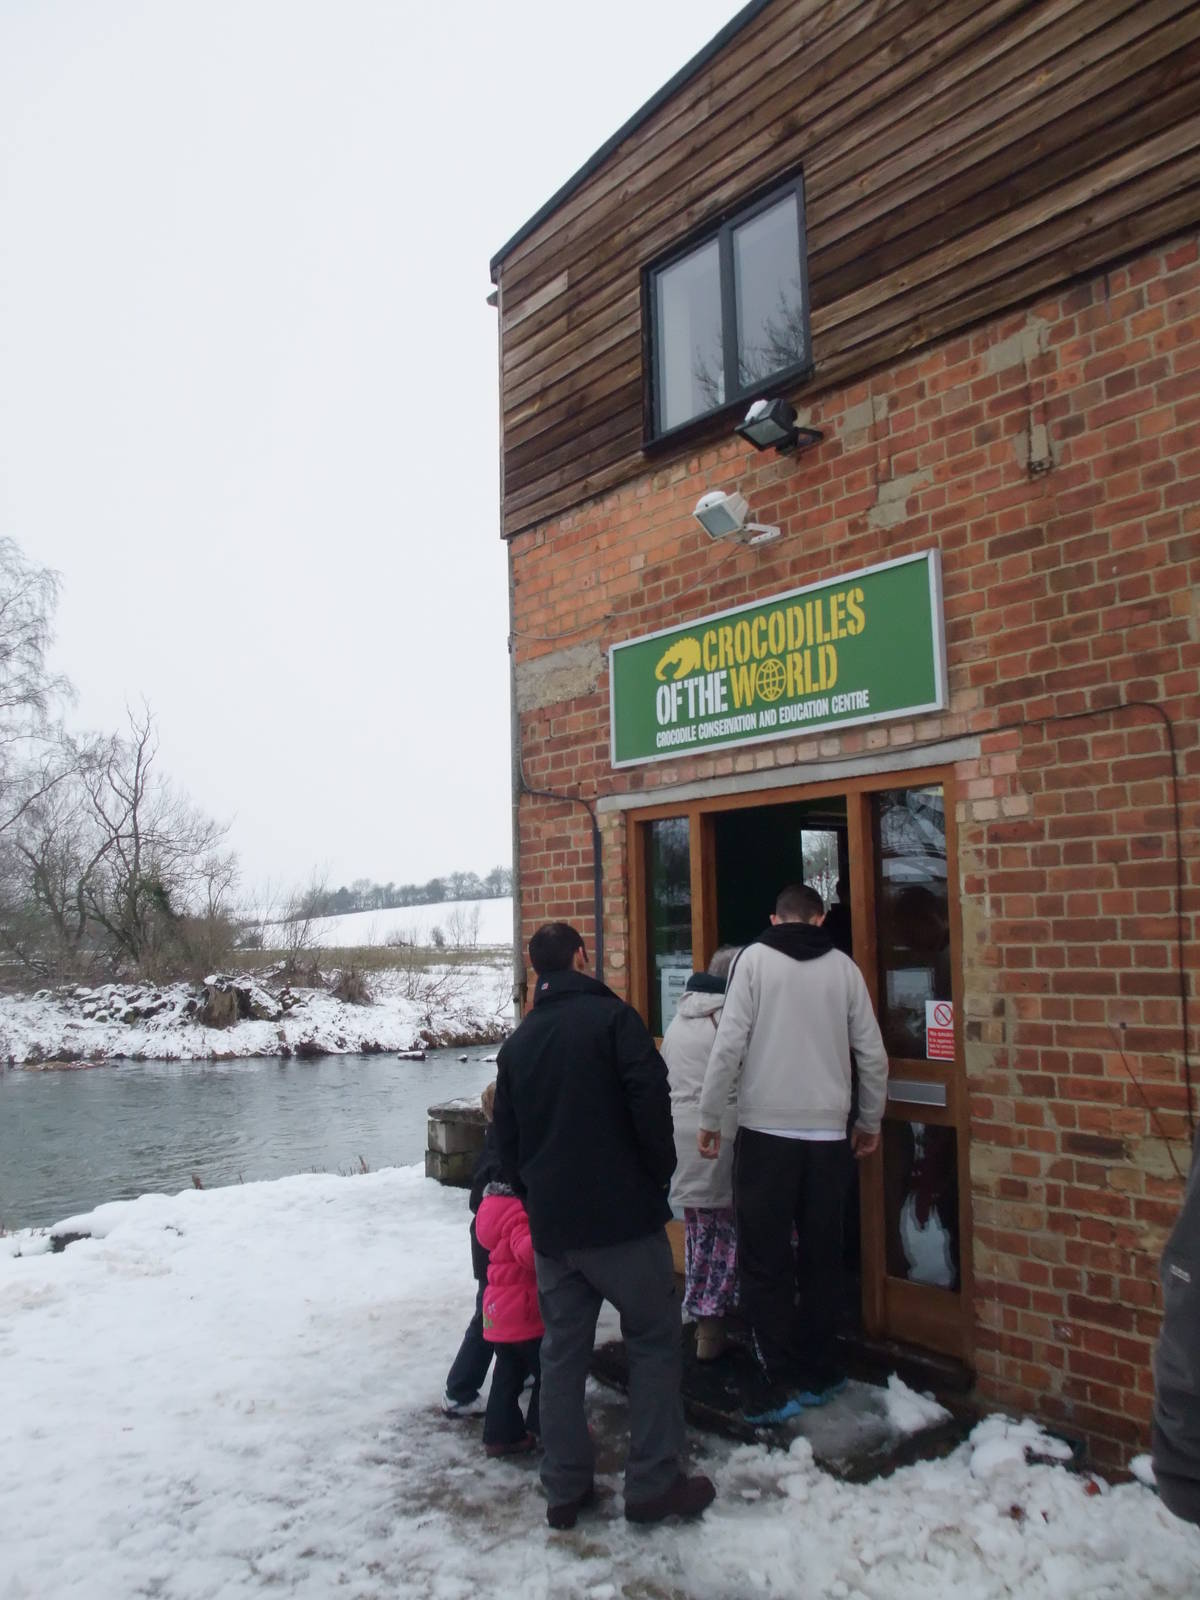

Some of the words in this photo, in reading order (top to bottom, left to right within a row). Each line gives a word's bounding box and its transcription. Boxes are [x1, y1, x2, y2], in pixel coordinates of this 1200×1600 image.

[703, 587, 866, 672] CROCODILES
[730, 644, 838, 709] WORLD
[656, 725, 697, 748] CROCODILE
[698, 712, 757, 740] CONSERVATION
[759, 709, 777, 728] AND
[779, 698, 829, 724] EDUCATION
[831, 689, 870, 714] CENTRE
